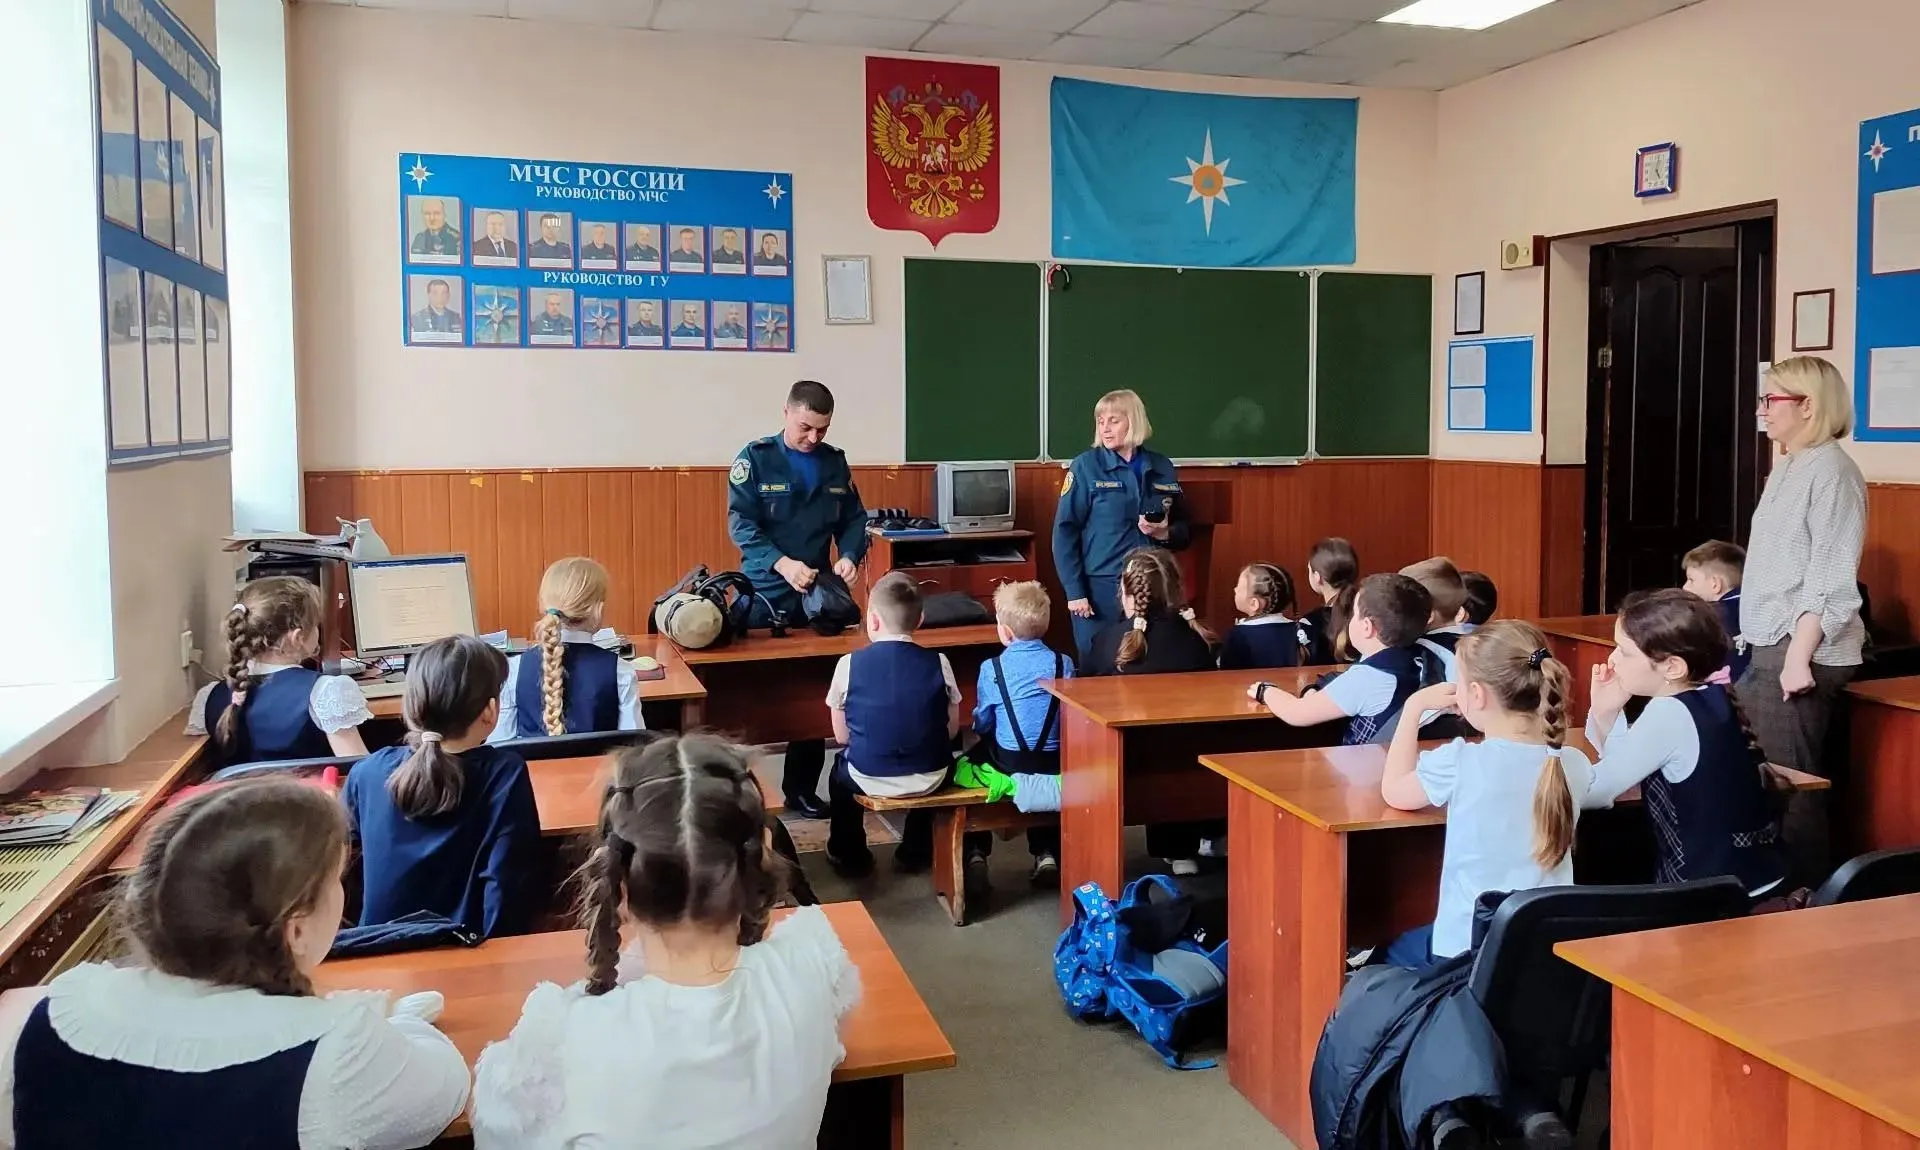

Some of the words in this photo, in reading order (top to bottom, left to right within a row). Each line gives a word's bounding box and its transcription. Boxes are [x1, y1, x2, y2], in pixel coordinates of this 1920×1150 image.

[509, 163, 570, 185] МЧС
[577, 167, 686, 191] РОССИИ
[536, 185, 636, 202] РУКОВОДСТВО
[638, 190, 669, 203] МЧС
[543, 271, 643, 286] РУКОВОДСТВО
[650, 275, 670, 287] ГУ
